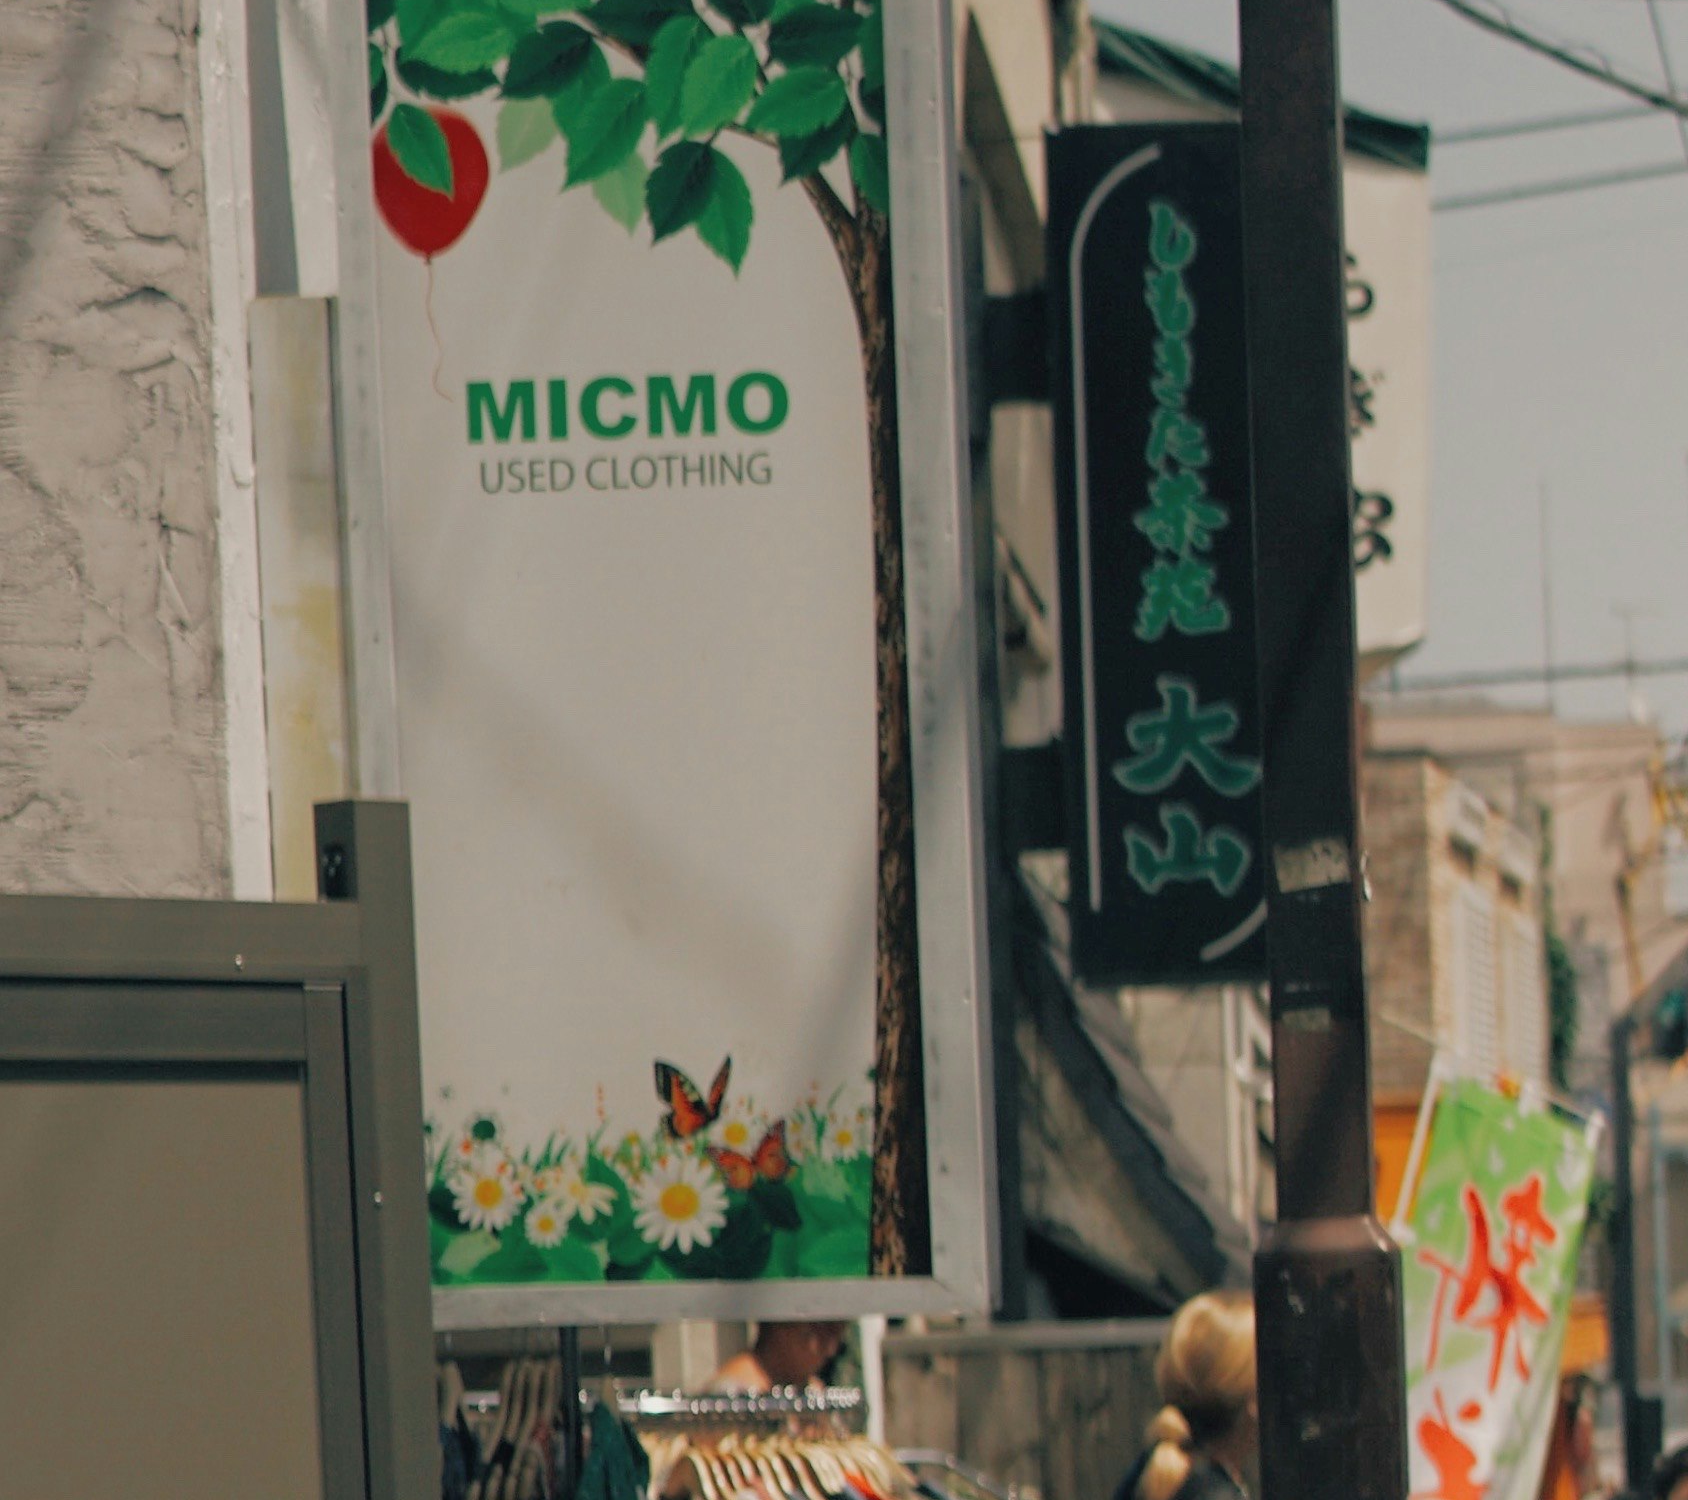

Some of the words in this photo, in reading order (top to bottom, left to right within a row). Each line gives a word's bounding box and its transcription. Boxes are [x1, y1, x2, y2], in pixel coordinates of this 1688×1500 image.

[466, 372, 789, 446] MICMO
[480, 457, 575, 495] USED
[584, 451, 773, 491] CLOTHING
[1112, 674, 1263, 898] 大山
